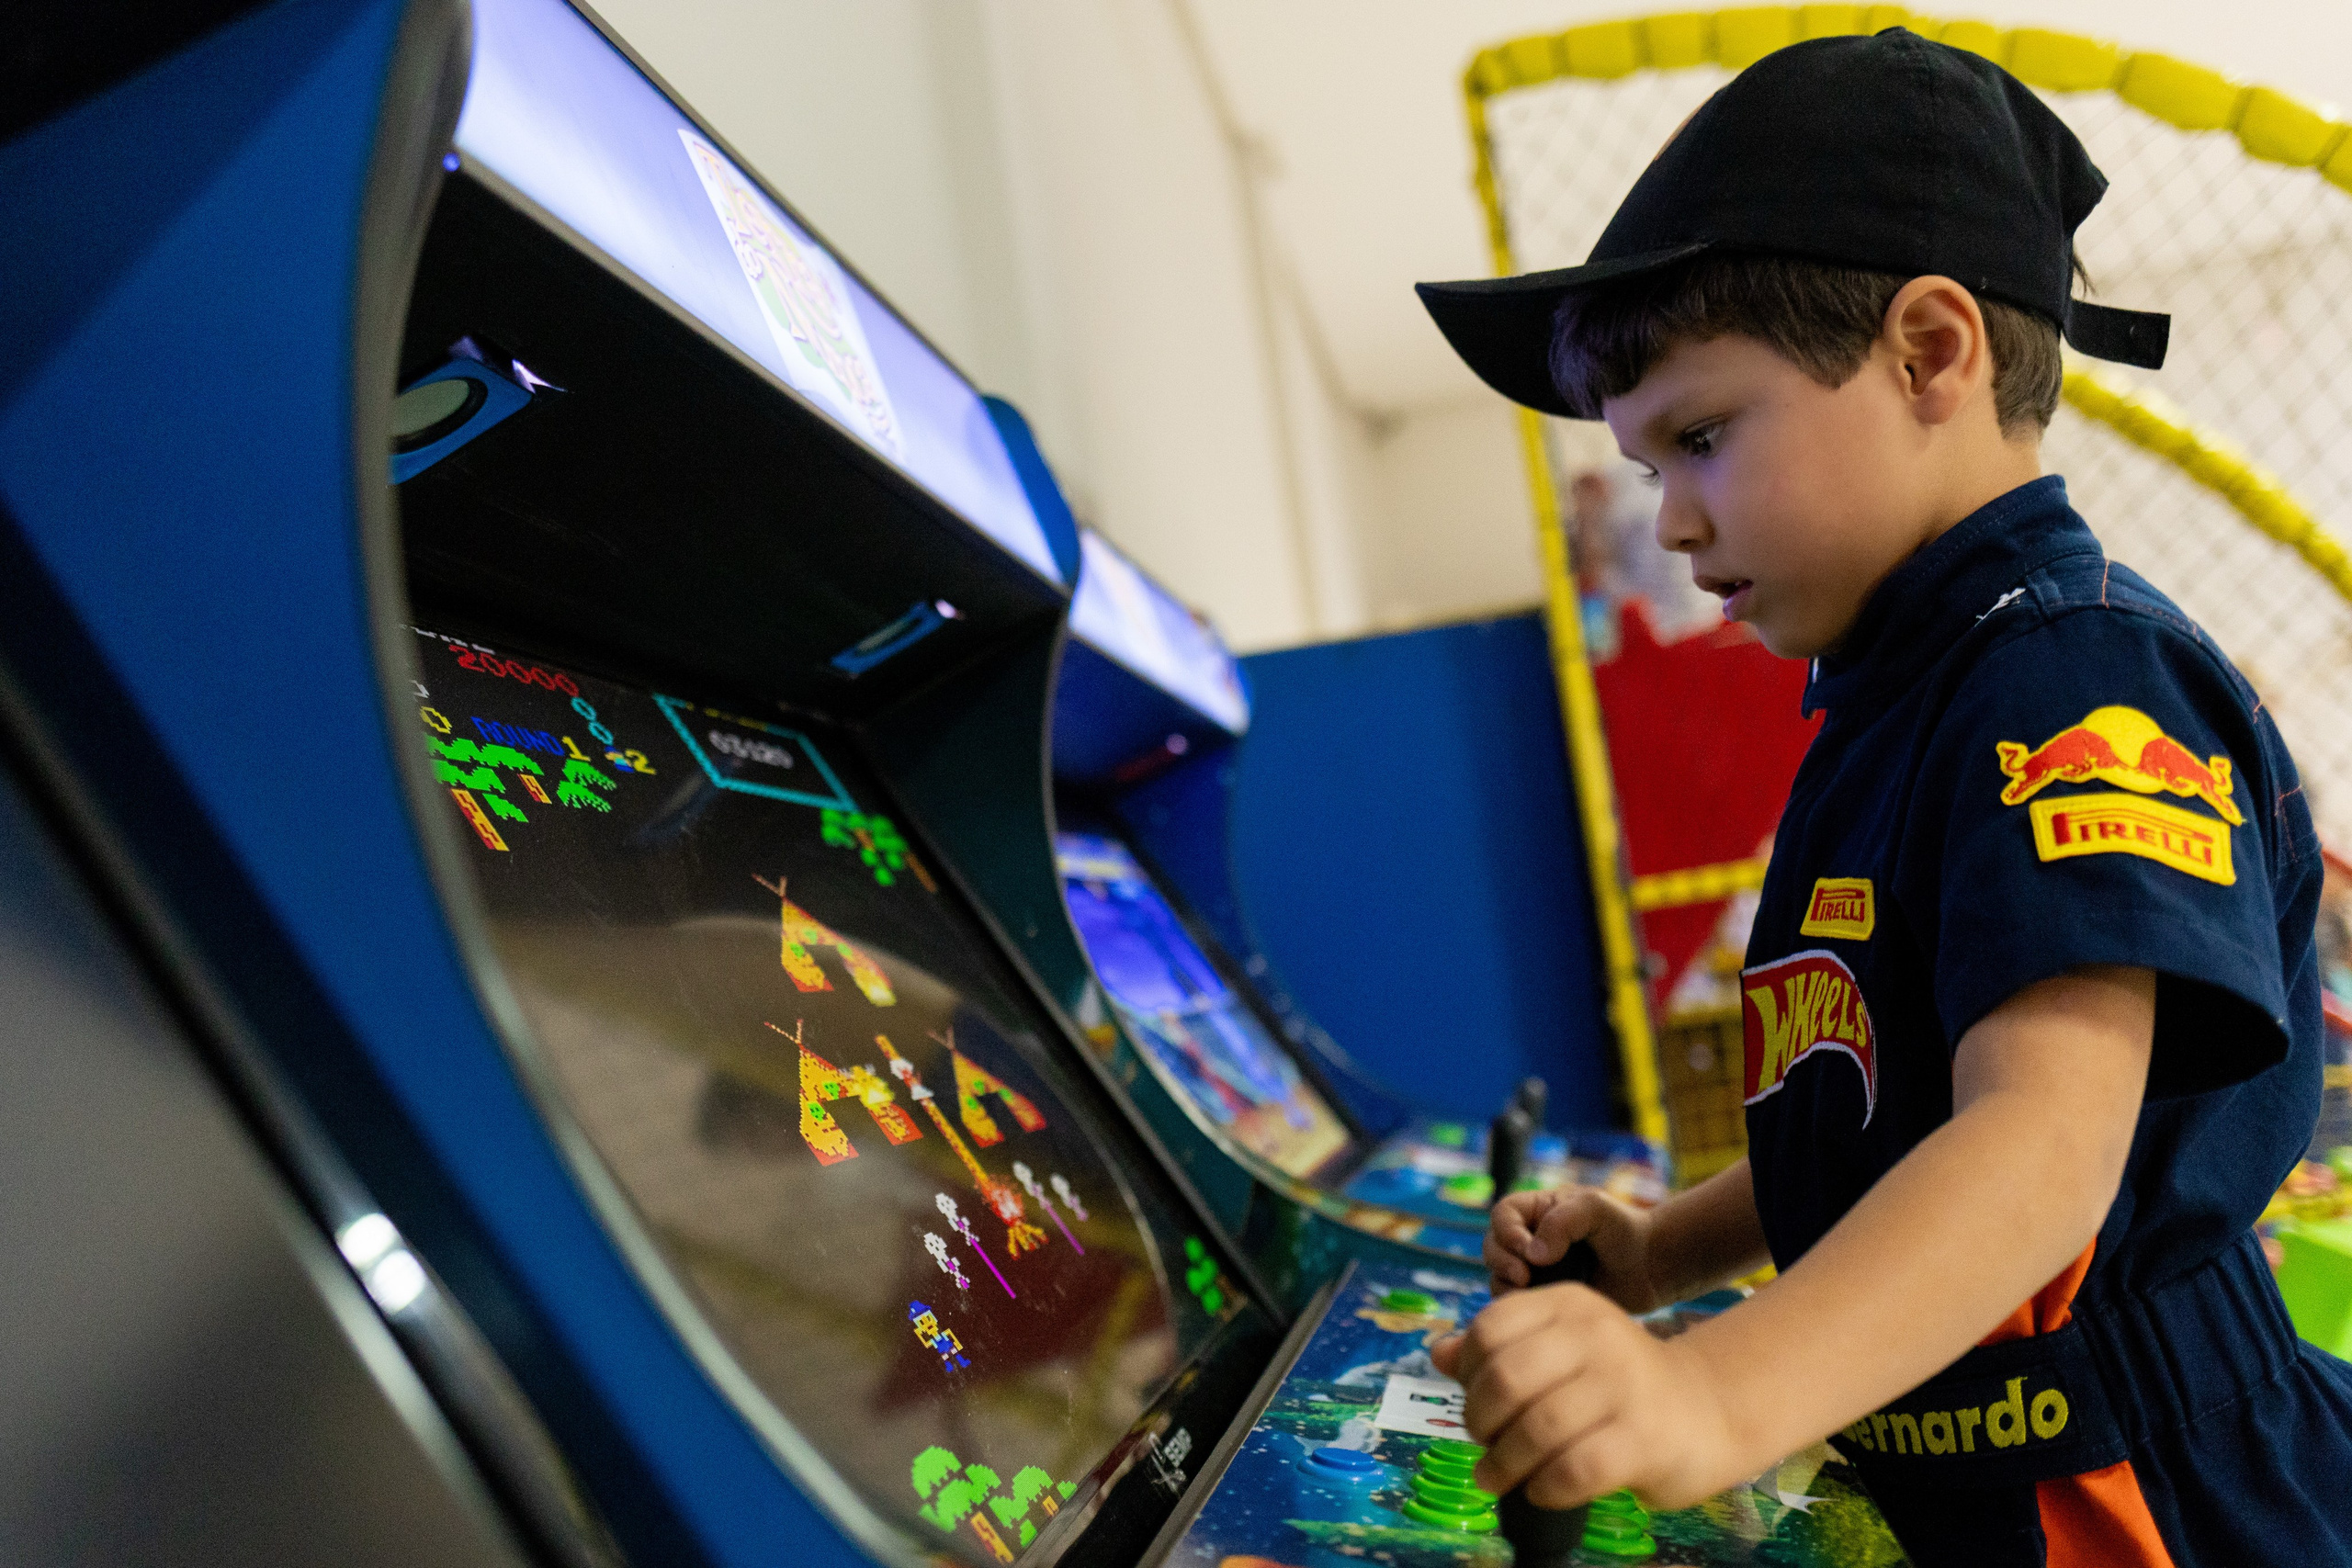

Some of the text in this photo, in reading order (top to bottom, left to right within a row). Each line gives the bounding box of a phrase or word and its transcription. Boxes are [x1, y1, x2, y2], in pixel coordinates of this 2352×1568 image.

[448, 644, 580, 698] 20000
[470, 716, 593, 761] ROUND 1
[625, 749, 657, 775] 2
[2051, 807, 2214, 867] PIRELLI
[1810, 887, 1866, 923] PIRELLI
[1841, 1376, 2069, 1456] ernardo
